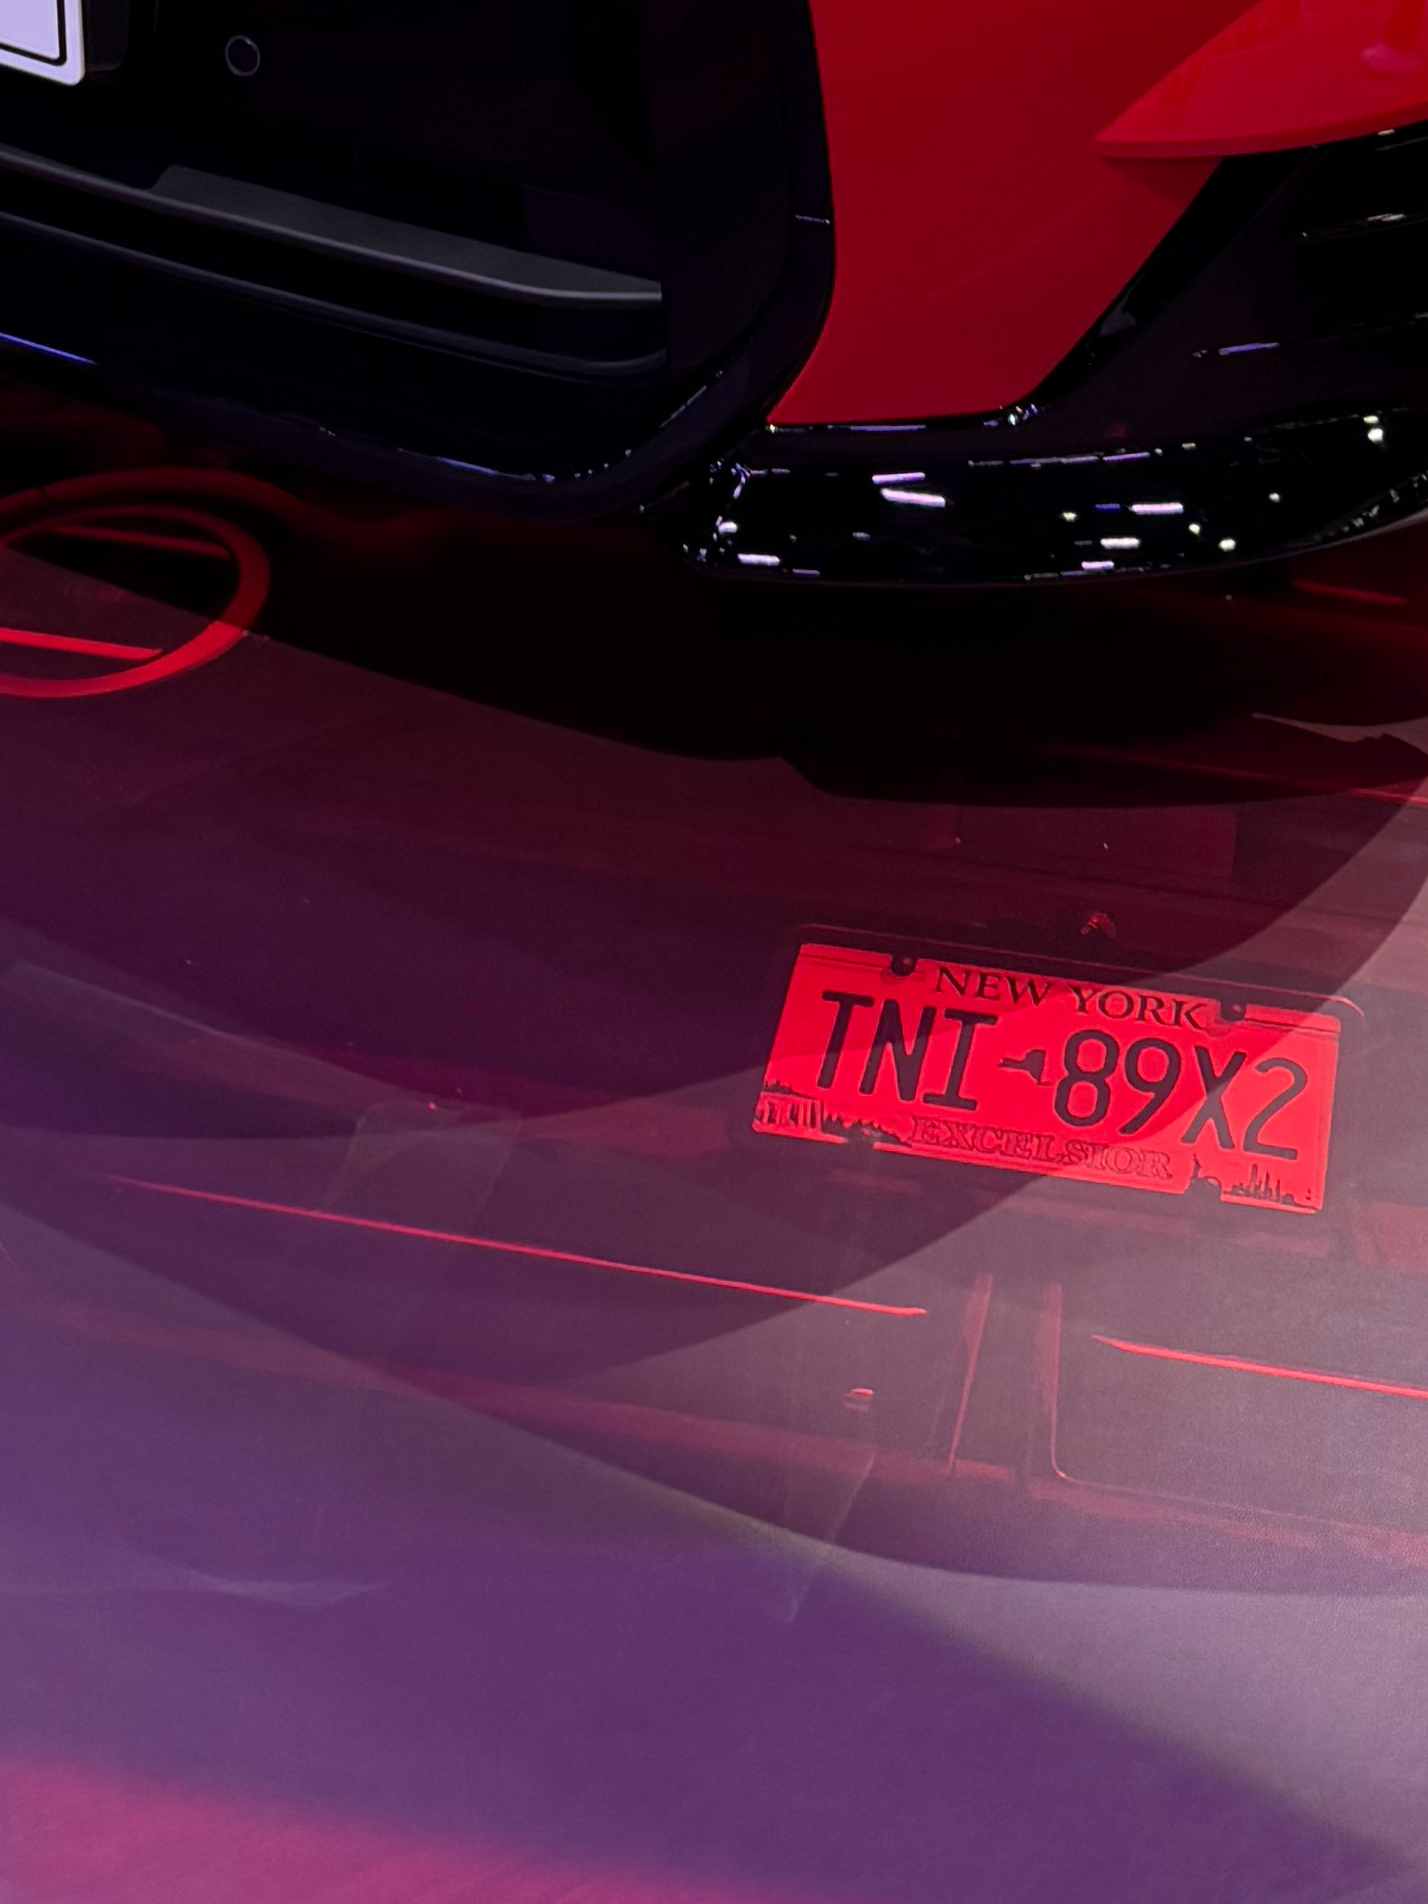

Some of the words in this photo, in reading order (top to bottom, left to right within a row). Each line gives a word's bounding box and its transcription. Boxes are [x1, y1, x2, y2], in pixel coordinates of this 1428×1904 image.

[934, 966, 1052, 1008] NEW
[1073, 986, 1206, 1030] YORK
[817, 990, 999, 1111] TNI
[1054, 1029, 1308, 1160] 89X2
[910, 1114, 1174, 1180] EXCELSIOR
